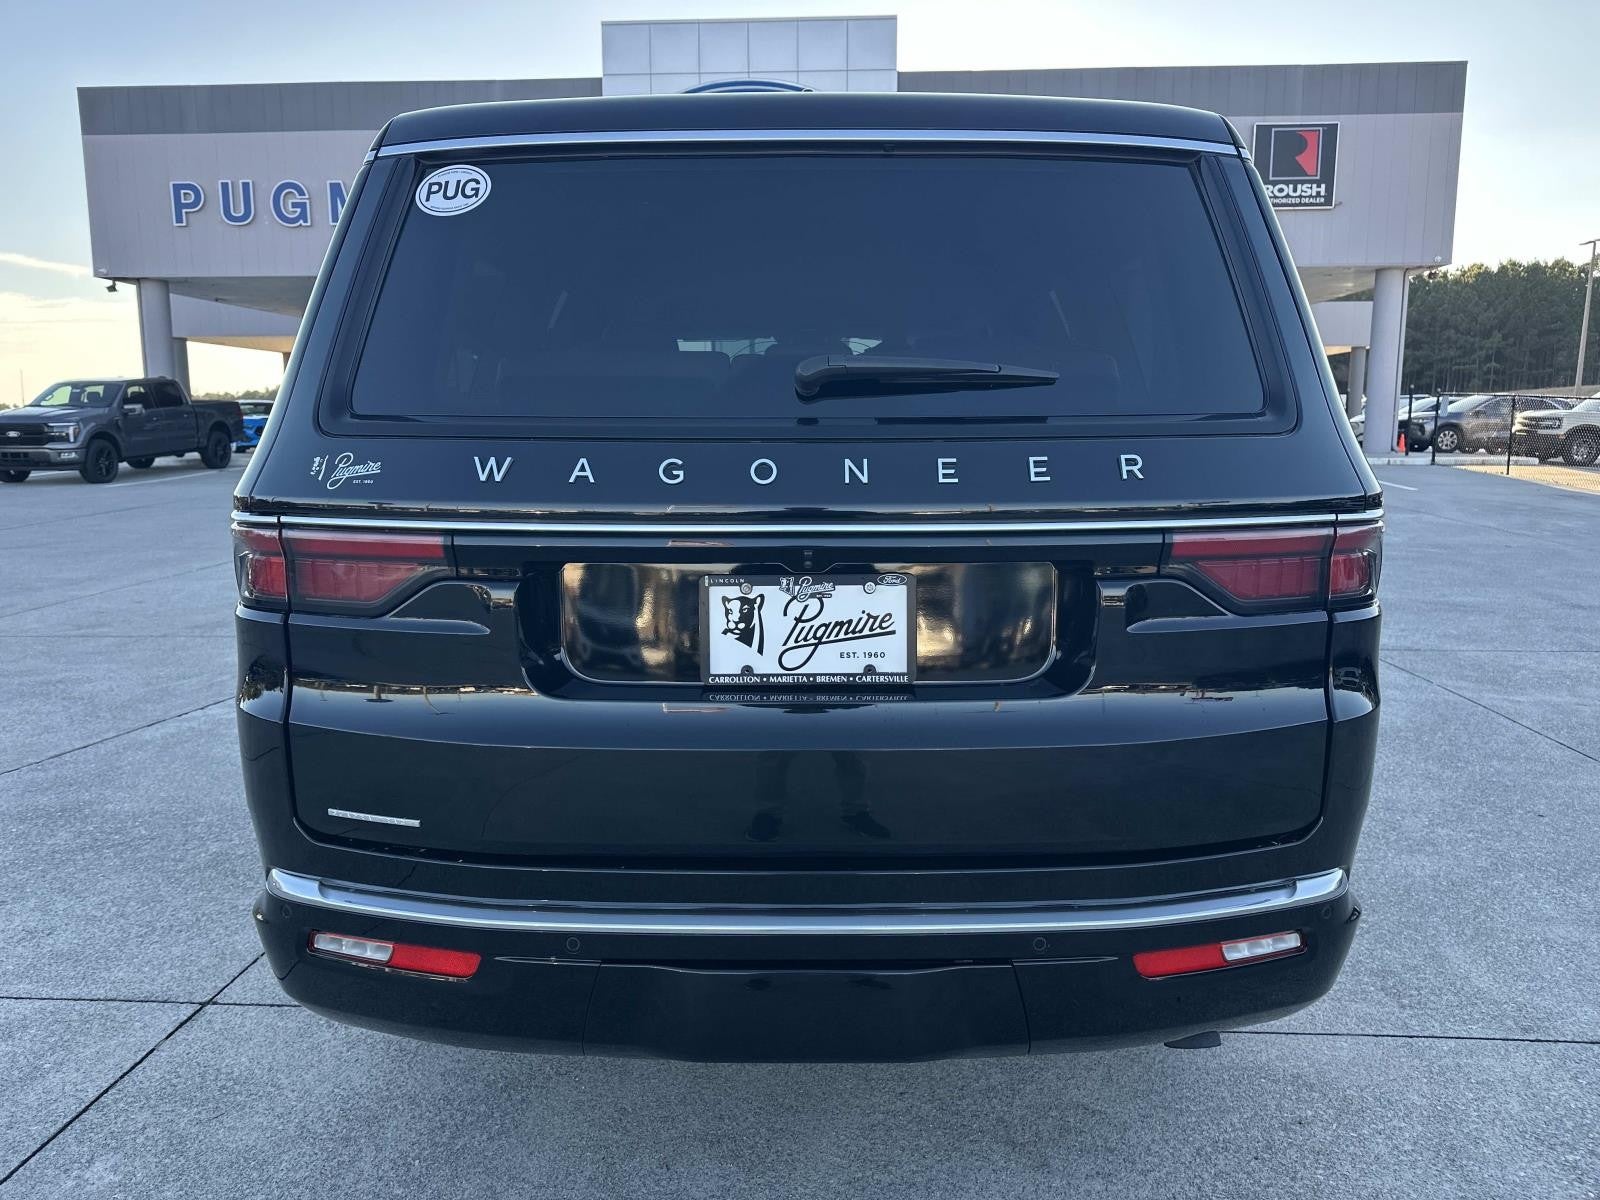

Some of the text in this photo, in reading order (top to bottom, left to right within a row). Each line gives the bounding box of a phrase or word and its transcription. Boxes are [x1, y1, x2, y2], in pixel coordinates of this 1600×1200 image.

[425, 178, 480, 202] PUG
[1264, 184, 1326, 197] ROUSH
[327, 452, 382, 489] Pugmire
[474, 454, 1145, 485] WAGONEER
[778, 594, 896, 671] Pugmire
[840, 651, 886, 659] EST. 1960
[709, 674, 909, 684] CARROLLTON MARIETTA BREMEN CARTERSVILLE
